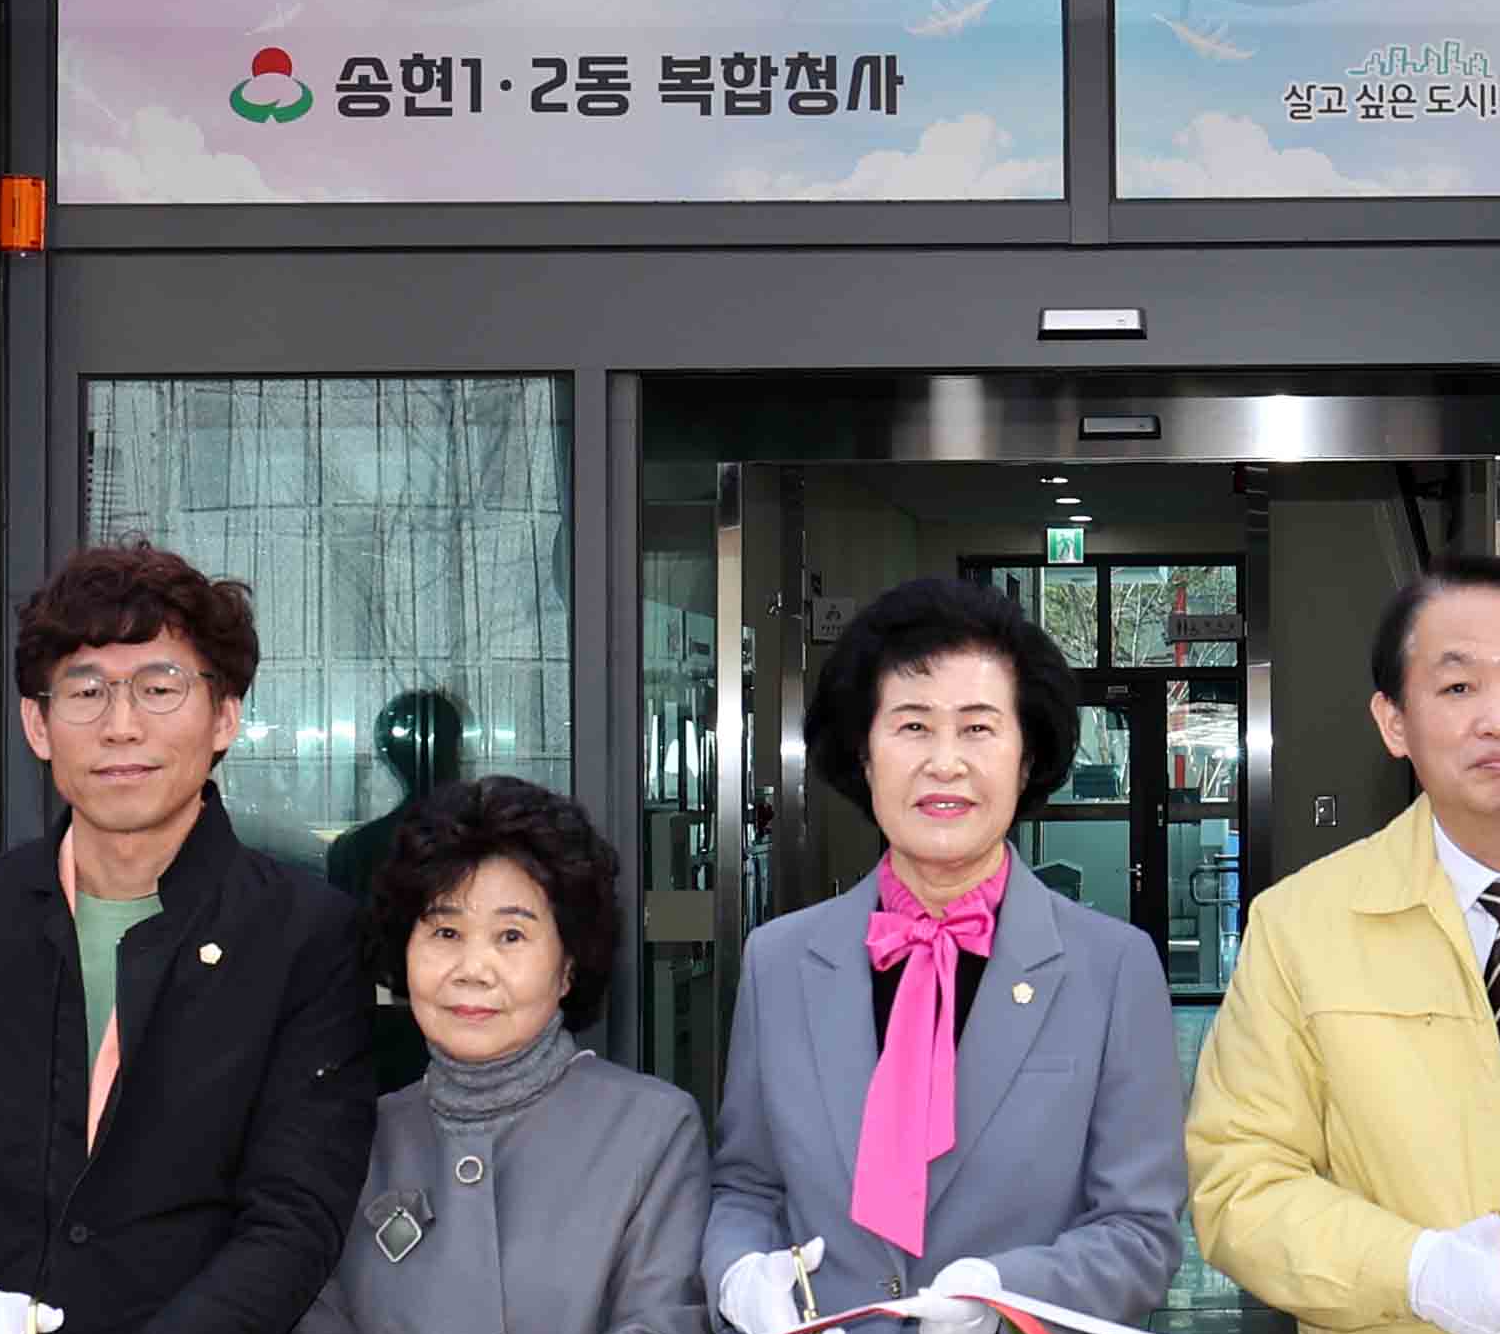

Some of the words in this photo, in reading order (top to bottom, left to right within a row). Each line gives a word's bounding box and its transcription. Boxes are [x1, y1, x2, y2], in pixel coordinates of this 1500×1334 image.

[659, 52, 903, 115] 복합청사
[1285, 85, 1346, 119] 살고
[1356, 84, 1416, 118] 싶은
[1427, 85, 1496, 116] 도시!
